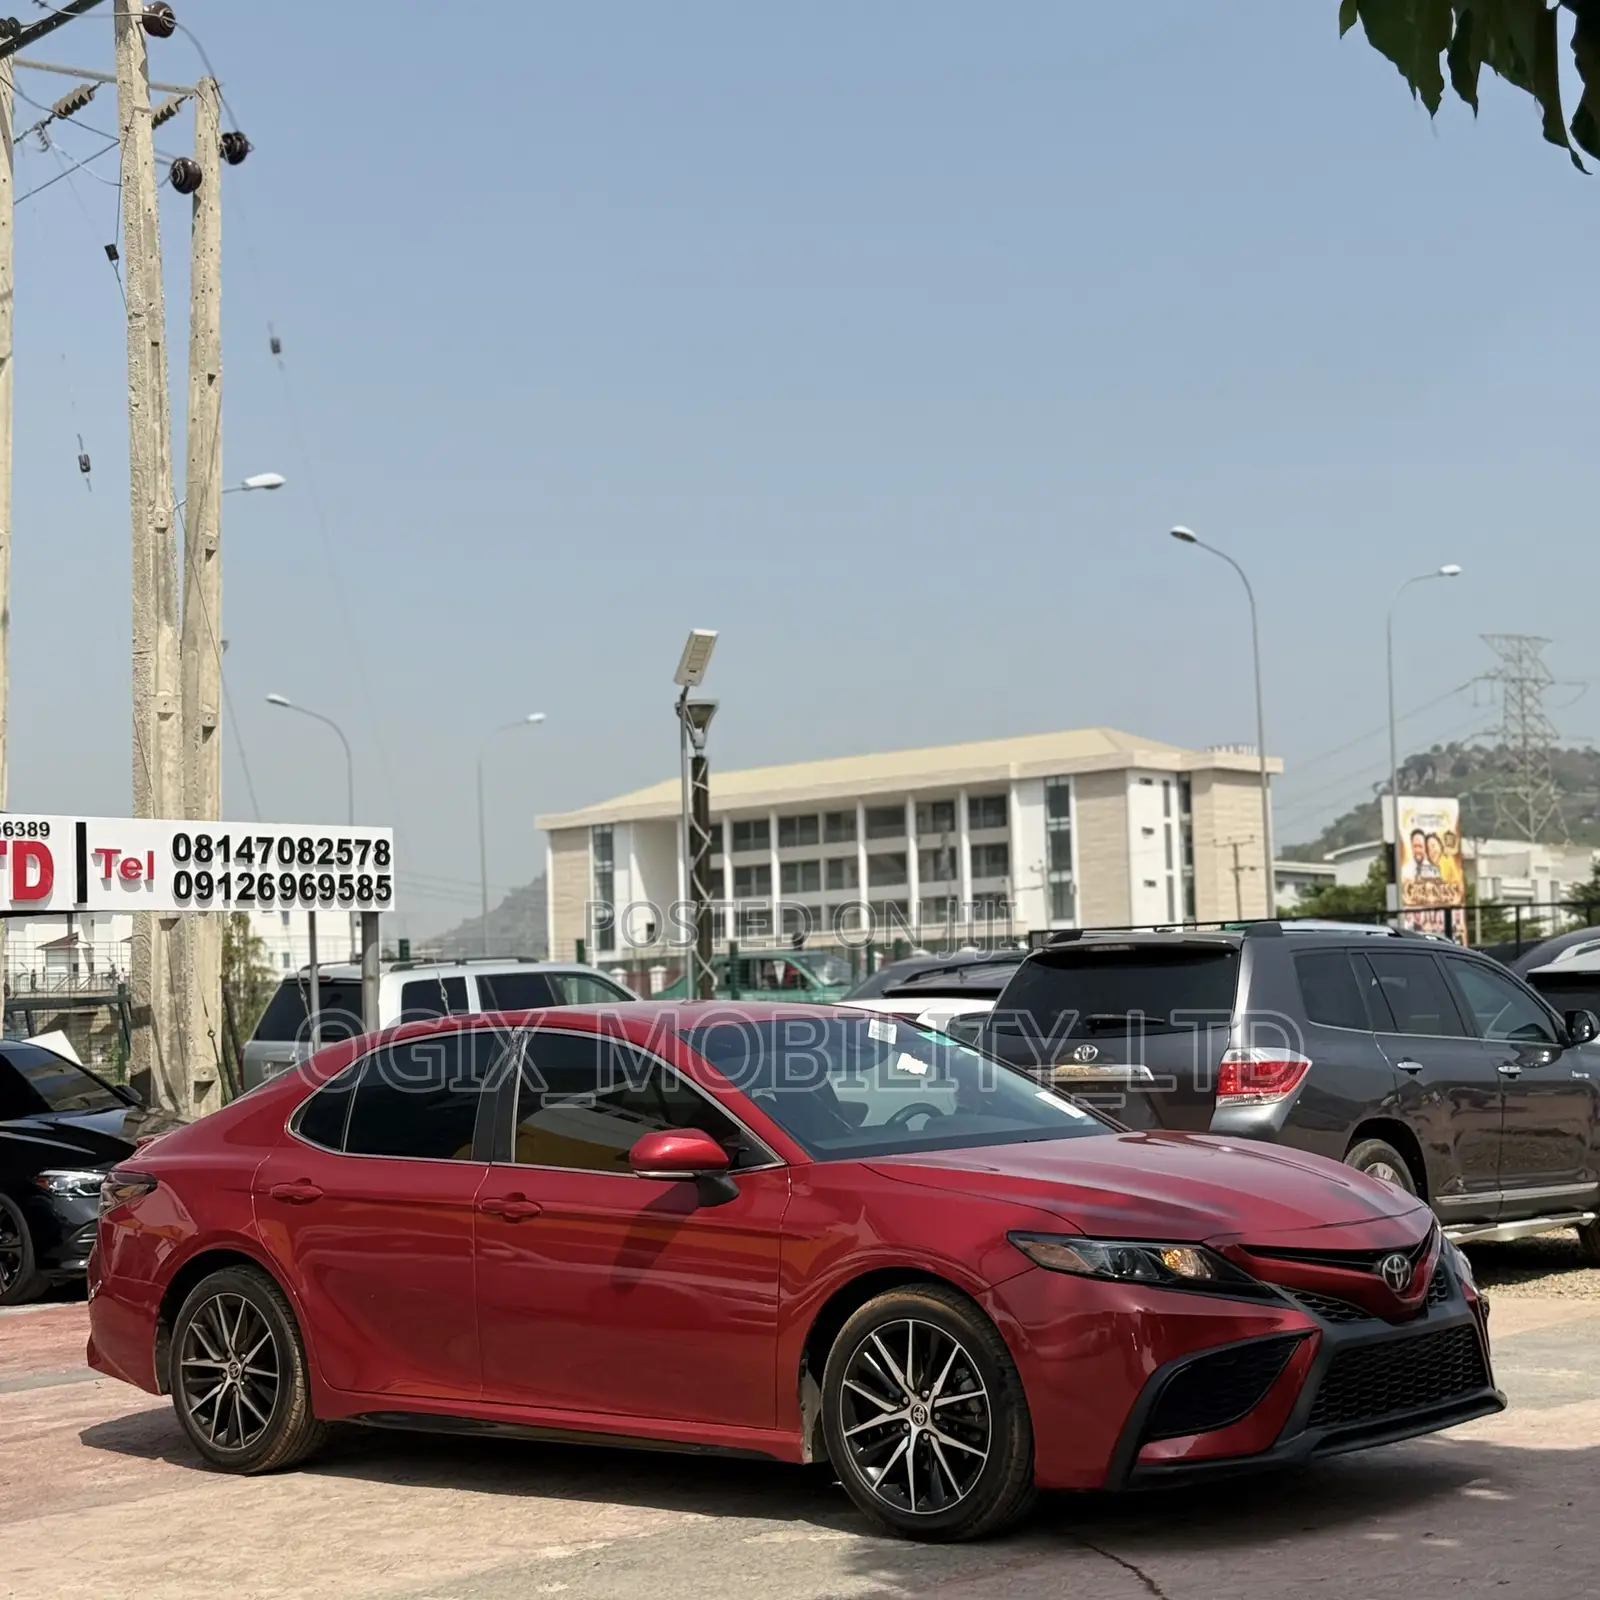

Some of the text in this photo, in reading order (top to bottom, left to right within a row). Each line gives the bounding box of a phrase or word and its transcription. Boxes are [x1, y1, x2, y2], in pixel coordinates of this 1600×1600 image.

[0, 821, 50, 837] 6389
[94, 848, 154, 880] Tel
[172, 833, 391, 866] 08147082578
[0, 840, 54, 900] D
[173, 870, 392, 901] 09126969585
